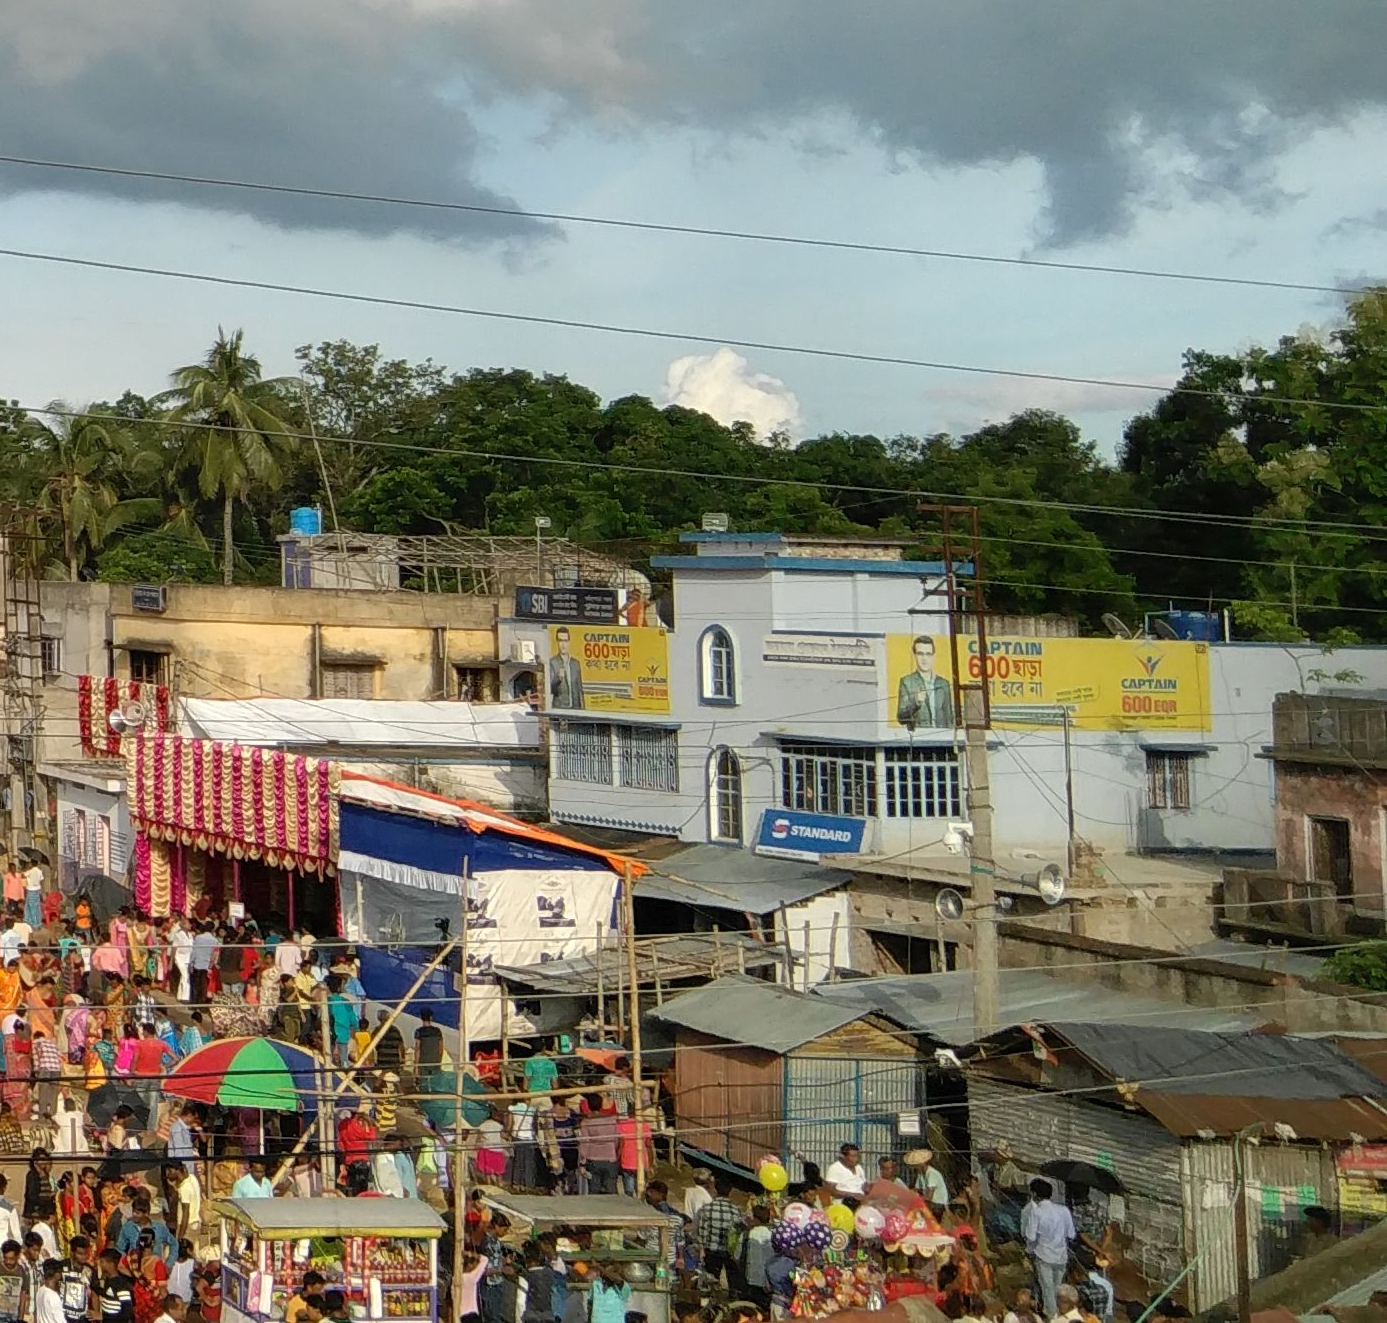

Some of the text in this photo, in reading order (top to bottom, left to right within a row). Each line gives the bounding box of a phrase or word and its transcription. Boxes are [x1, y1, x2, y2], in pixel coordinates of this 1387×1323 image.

[531, 593, 548, 614] SBI
[583, 633, 630, 644] CAPTAIN
[584, 643, 610, 658] 600
[969, 655, 1042, 680] 600 ছাড়া
[1001, 682, 1024, 698] হবে
[1028, 682, 1042, 698] না
[1121, 678, 1177, 690] CAPTAIN
[1122, 695, 1177, 714] 600 EQR
[790, 825, 852, 843] STANDARD
